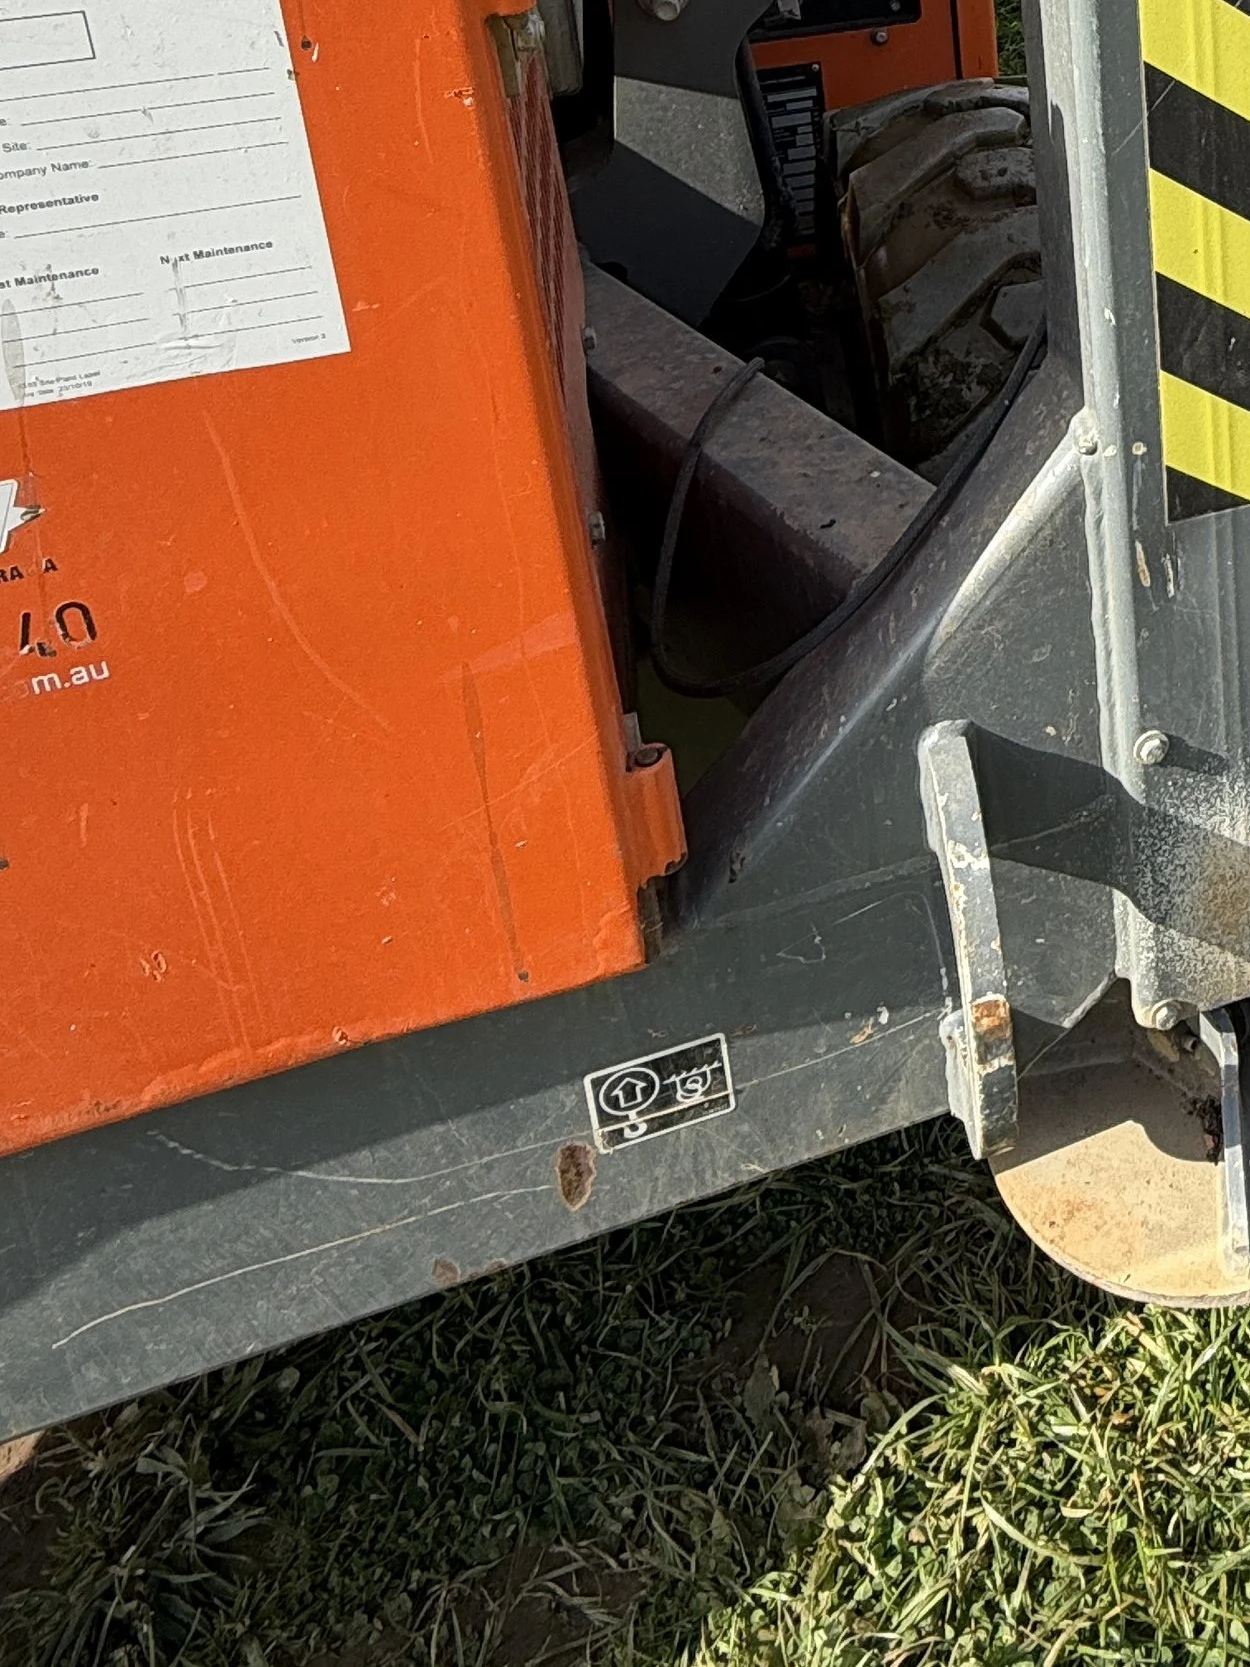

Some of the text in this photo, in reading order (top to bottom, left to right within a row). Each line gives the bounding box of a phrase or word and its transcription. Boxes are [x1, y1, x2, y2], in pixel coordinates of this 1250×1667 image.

[0, 194, 99, 215] Representative
[160, 241, 273, 265] Nxt Maintenance
[14, 267, 99, 287] Maintenance
